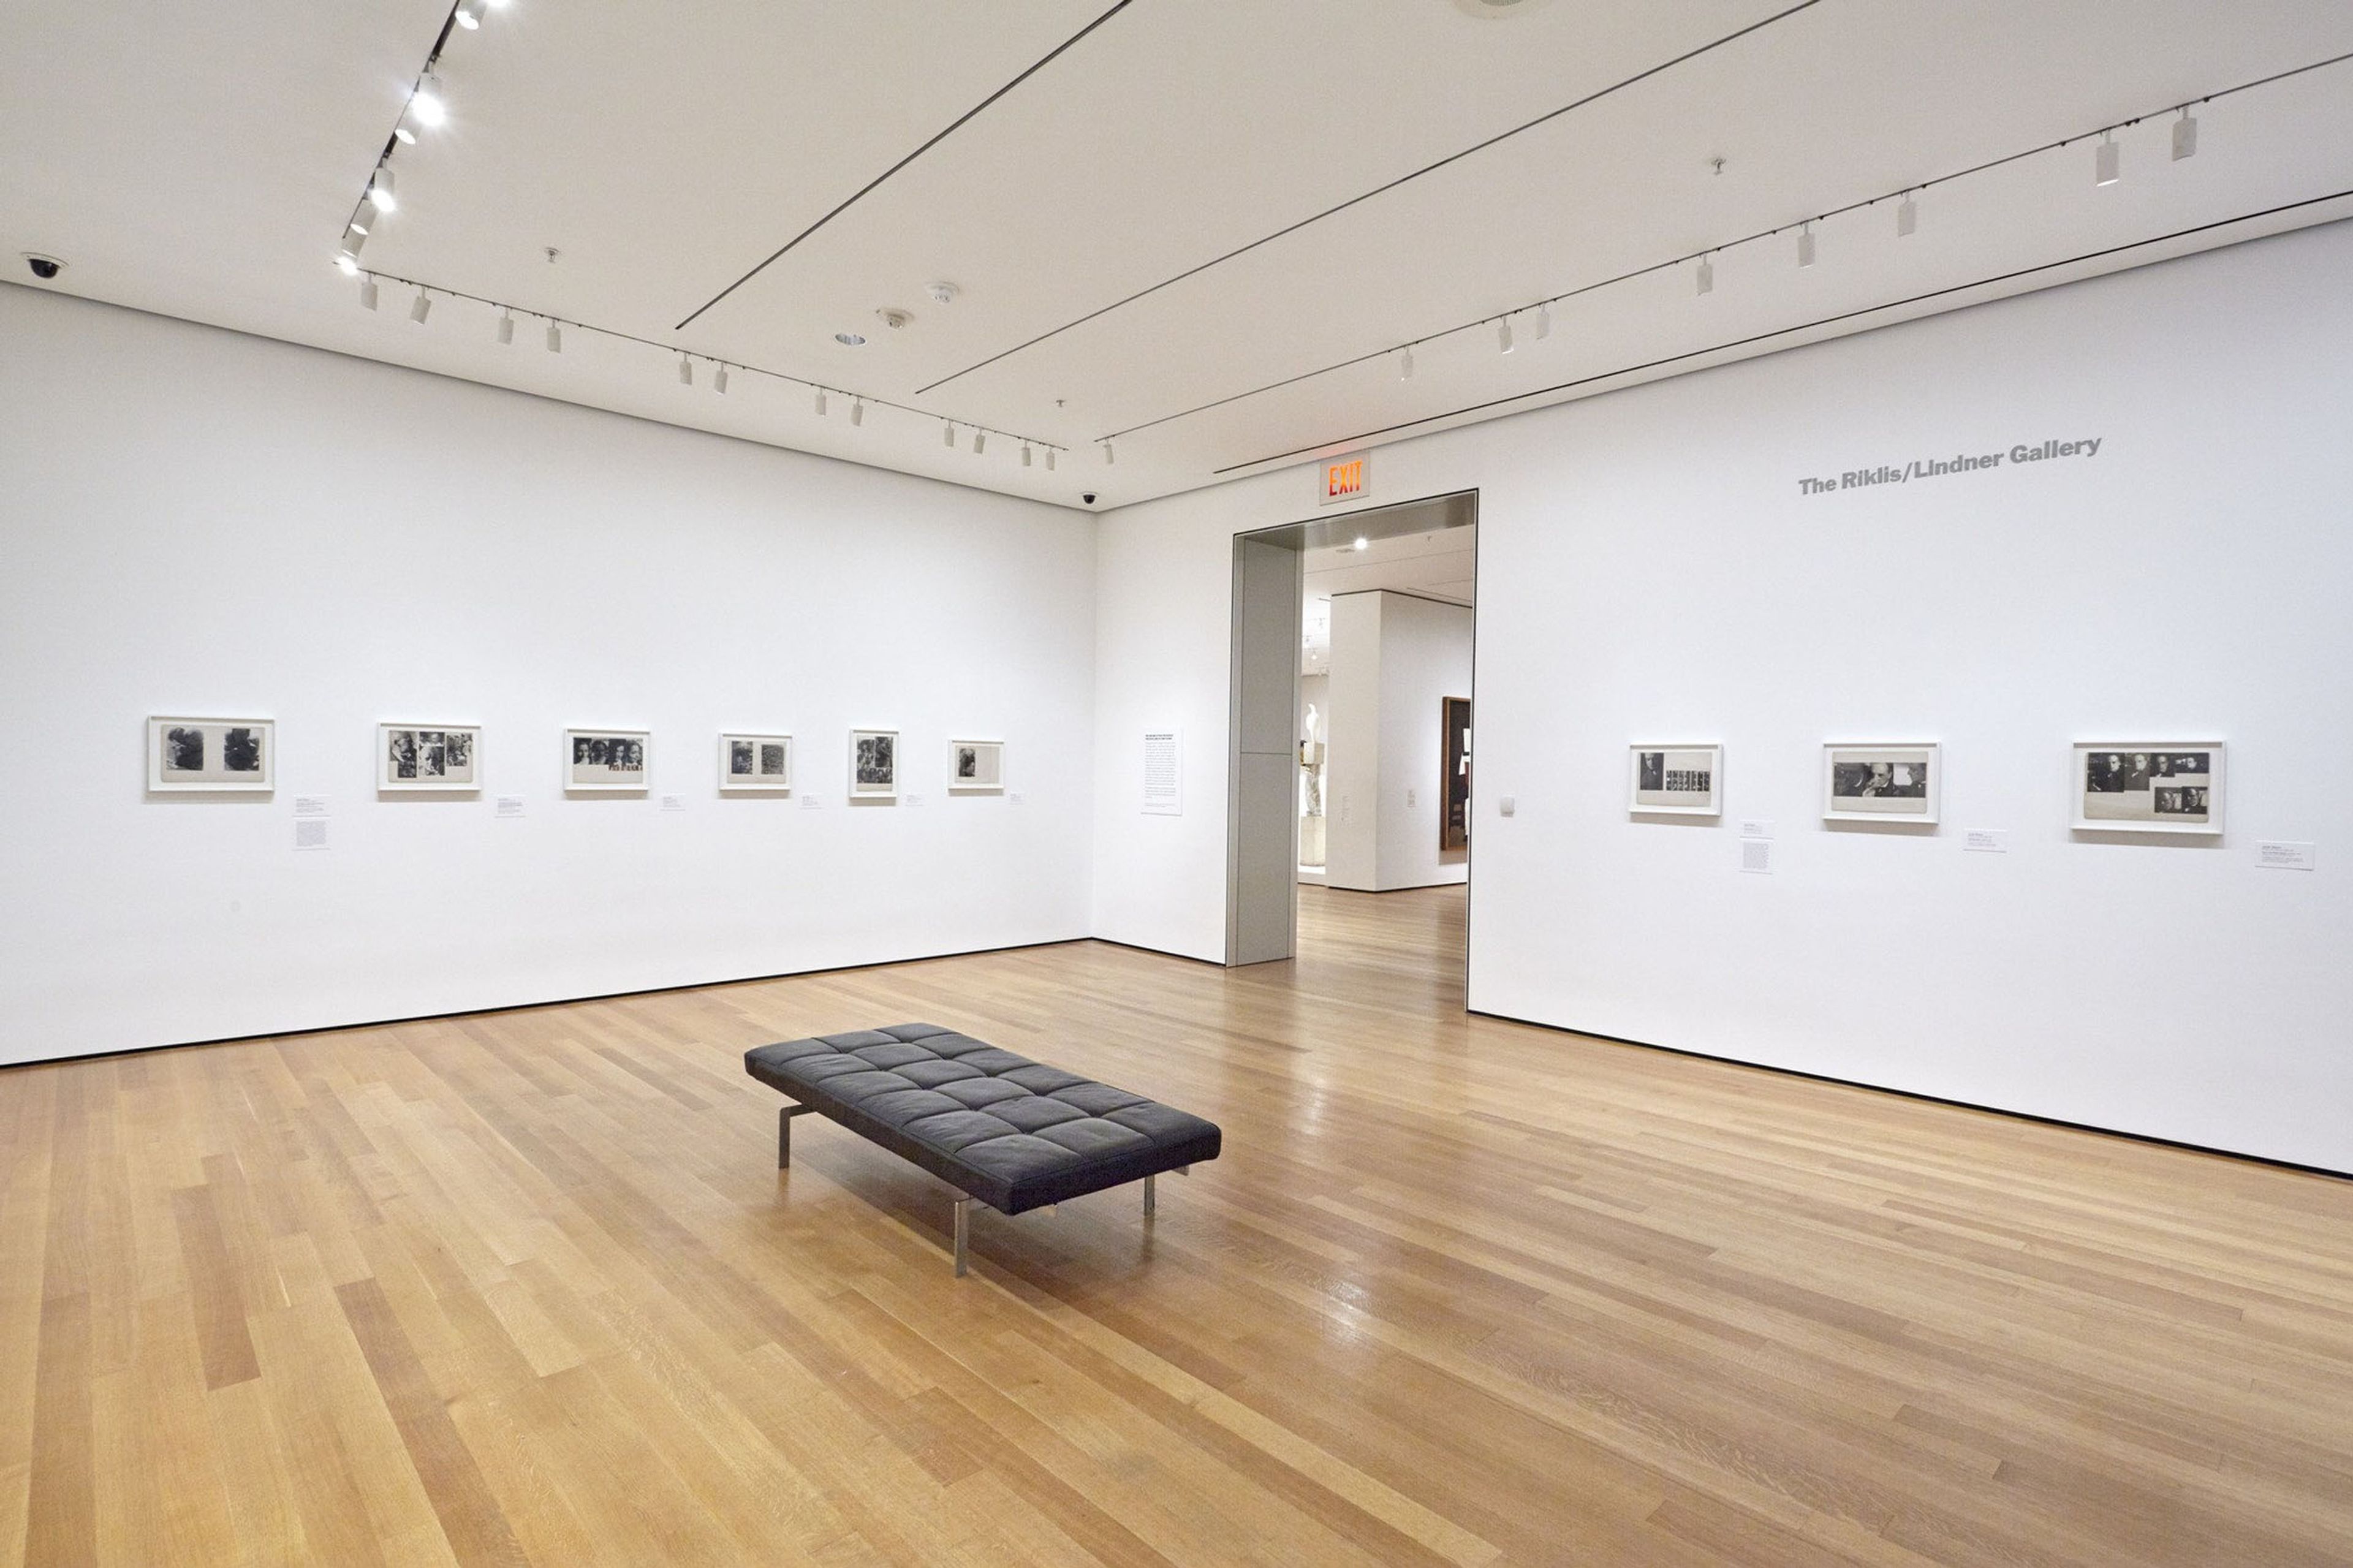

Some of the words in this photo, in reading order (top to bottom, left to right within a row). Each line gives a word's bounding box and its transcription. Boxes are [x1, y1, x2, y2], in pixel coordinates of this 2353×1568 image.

[1328, 459, 1363, 497] EXIT
[1798, 477, 1837, 495] The
[1841, 453, 2004, 490] Riklis/Lindner
[2009, 437, 2102, 464] Gallery
